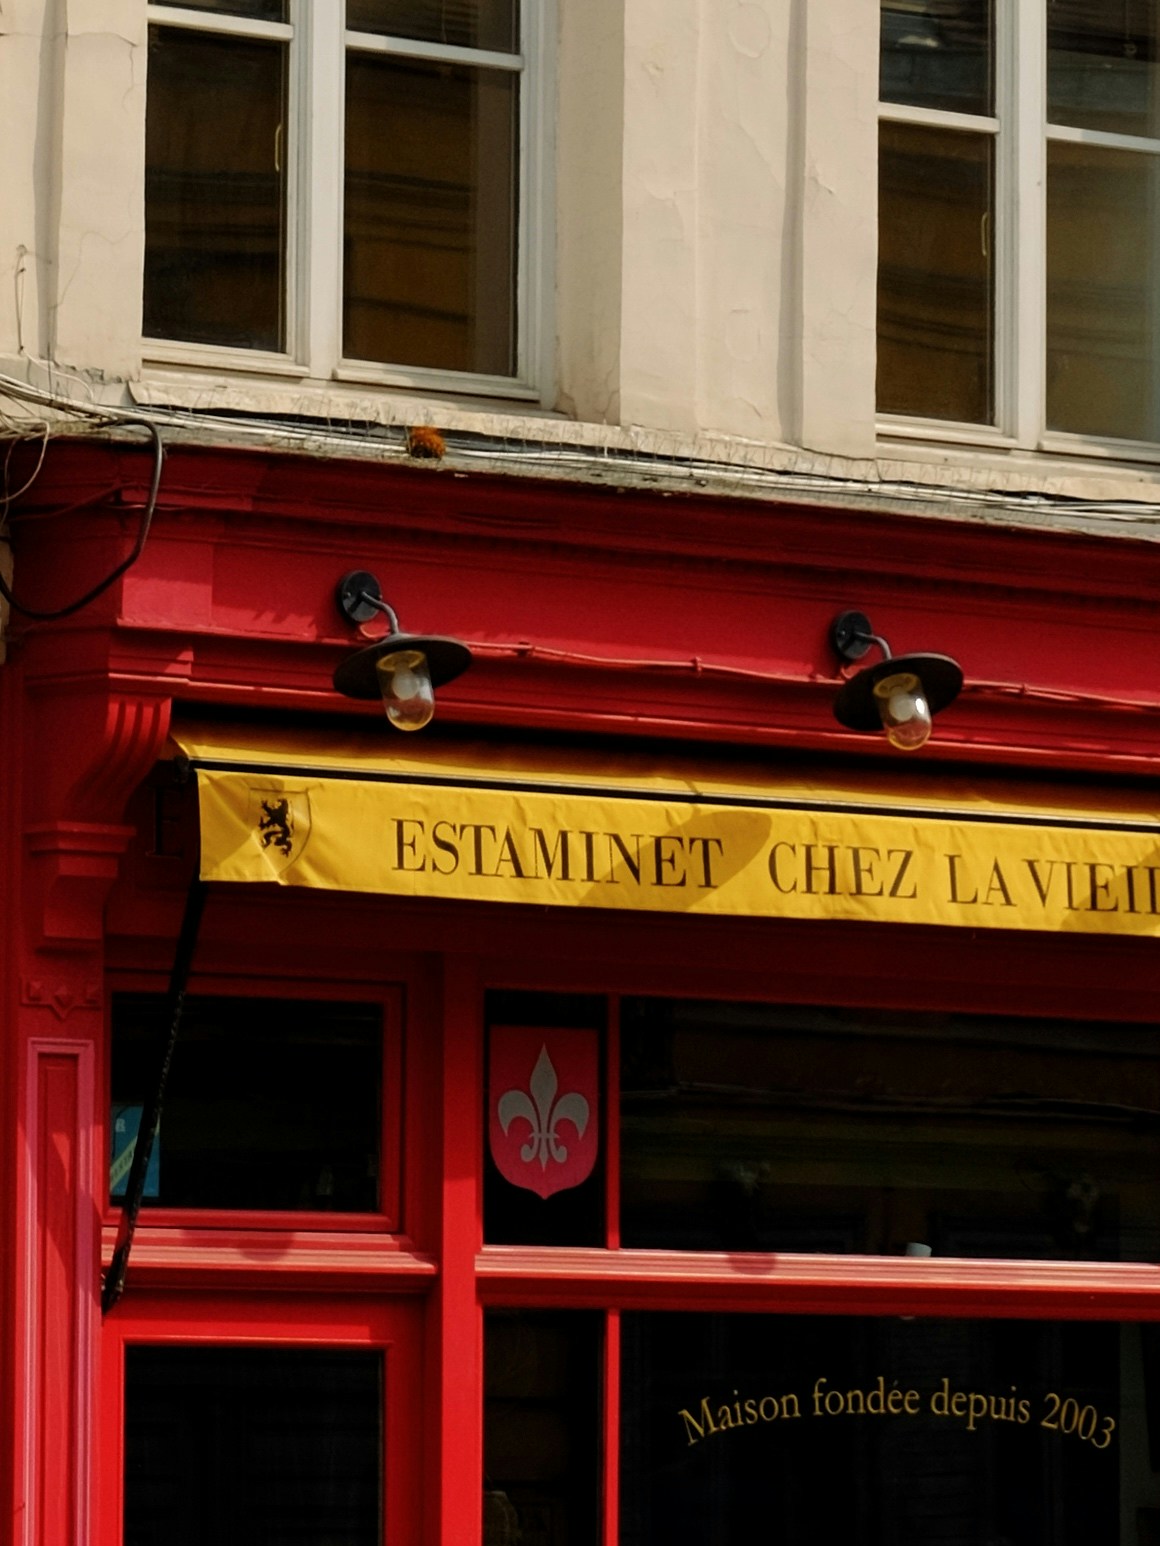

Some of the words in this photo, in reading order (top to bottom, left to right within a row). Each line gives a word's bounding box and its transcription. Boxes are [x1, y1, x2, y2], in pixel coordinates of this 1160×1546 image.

[391, 816, 724, 889] ESTAMINET
[768, 840, 918, 900] CHEZ
[678, 1389, 801, 1445] Maison
[812, 1376, 921, 1416] fondée
[930, 1377, 1031, 1432] depuis
[1040, 1392, 1116, 1450] 2003
